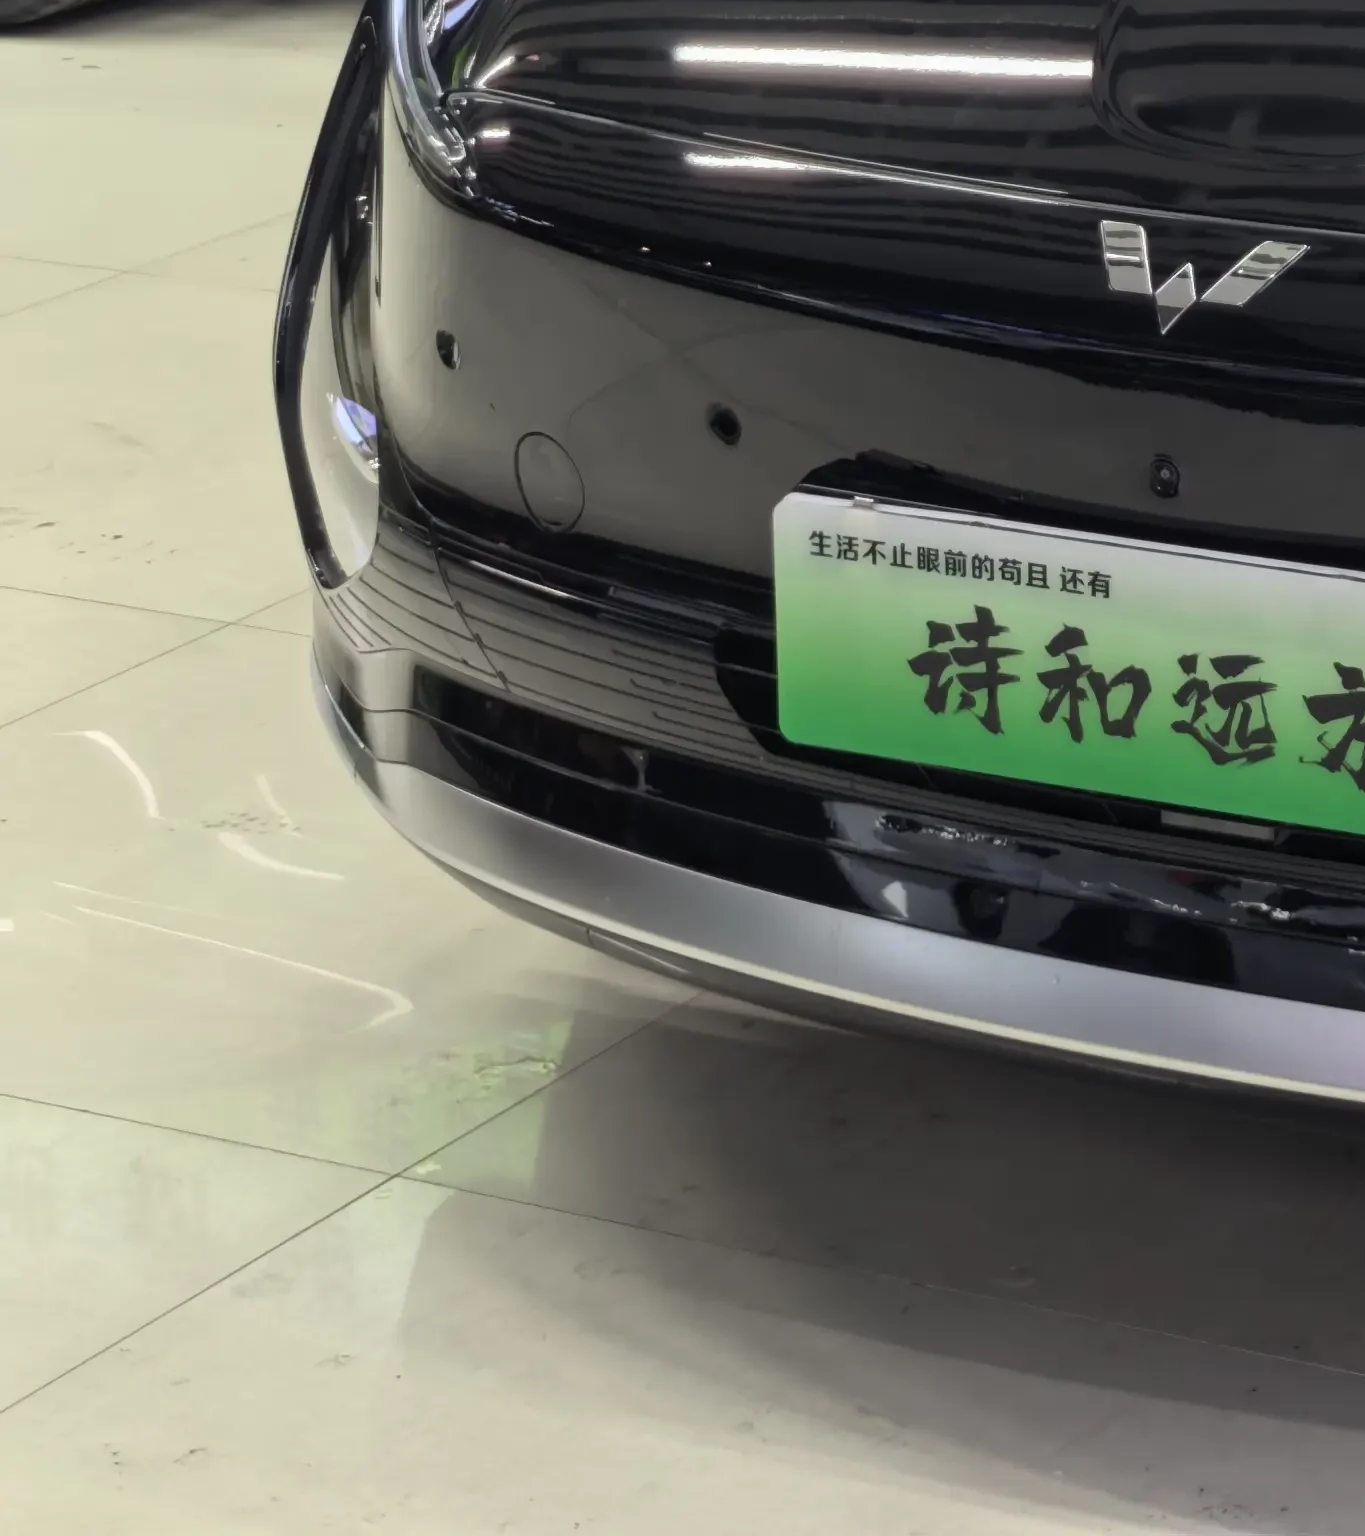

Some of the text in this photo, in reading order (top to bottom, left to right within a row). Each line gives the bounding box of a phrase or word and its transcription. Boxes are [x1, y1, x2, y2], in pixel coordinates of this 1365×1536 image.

[808, 530, 1112, 599] 生活不止眼前的苟且 还有
